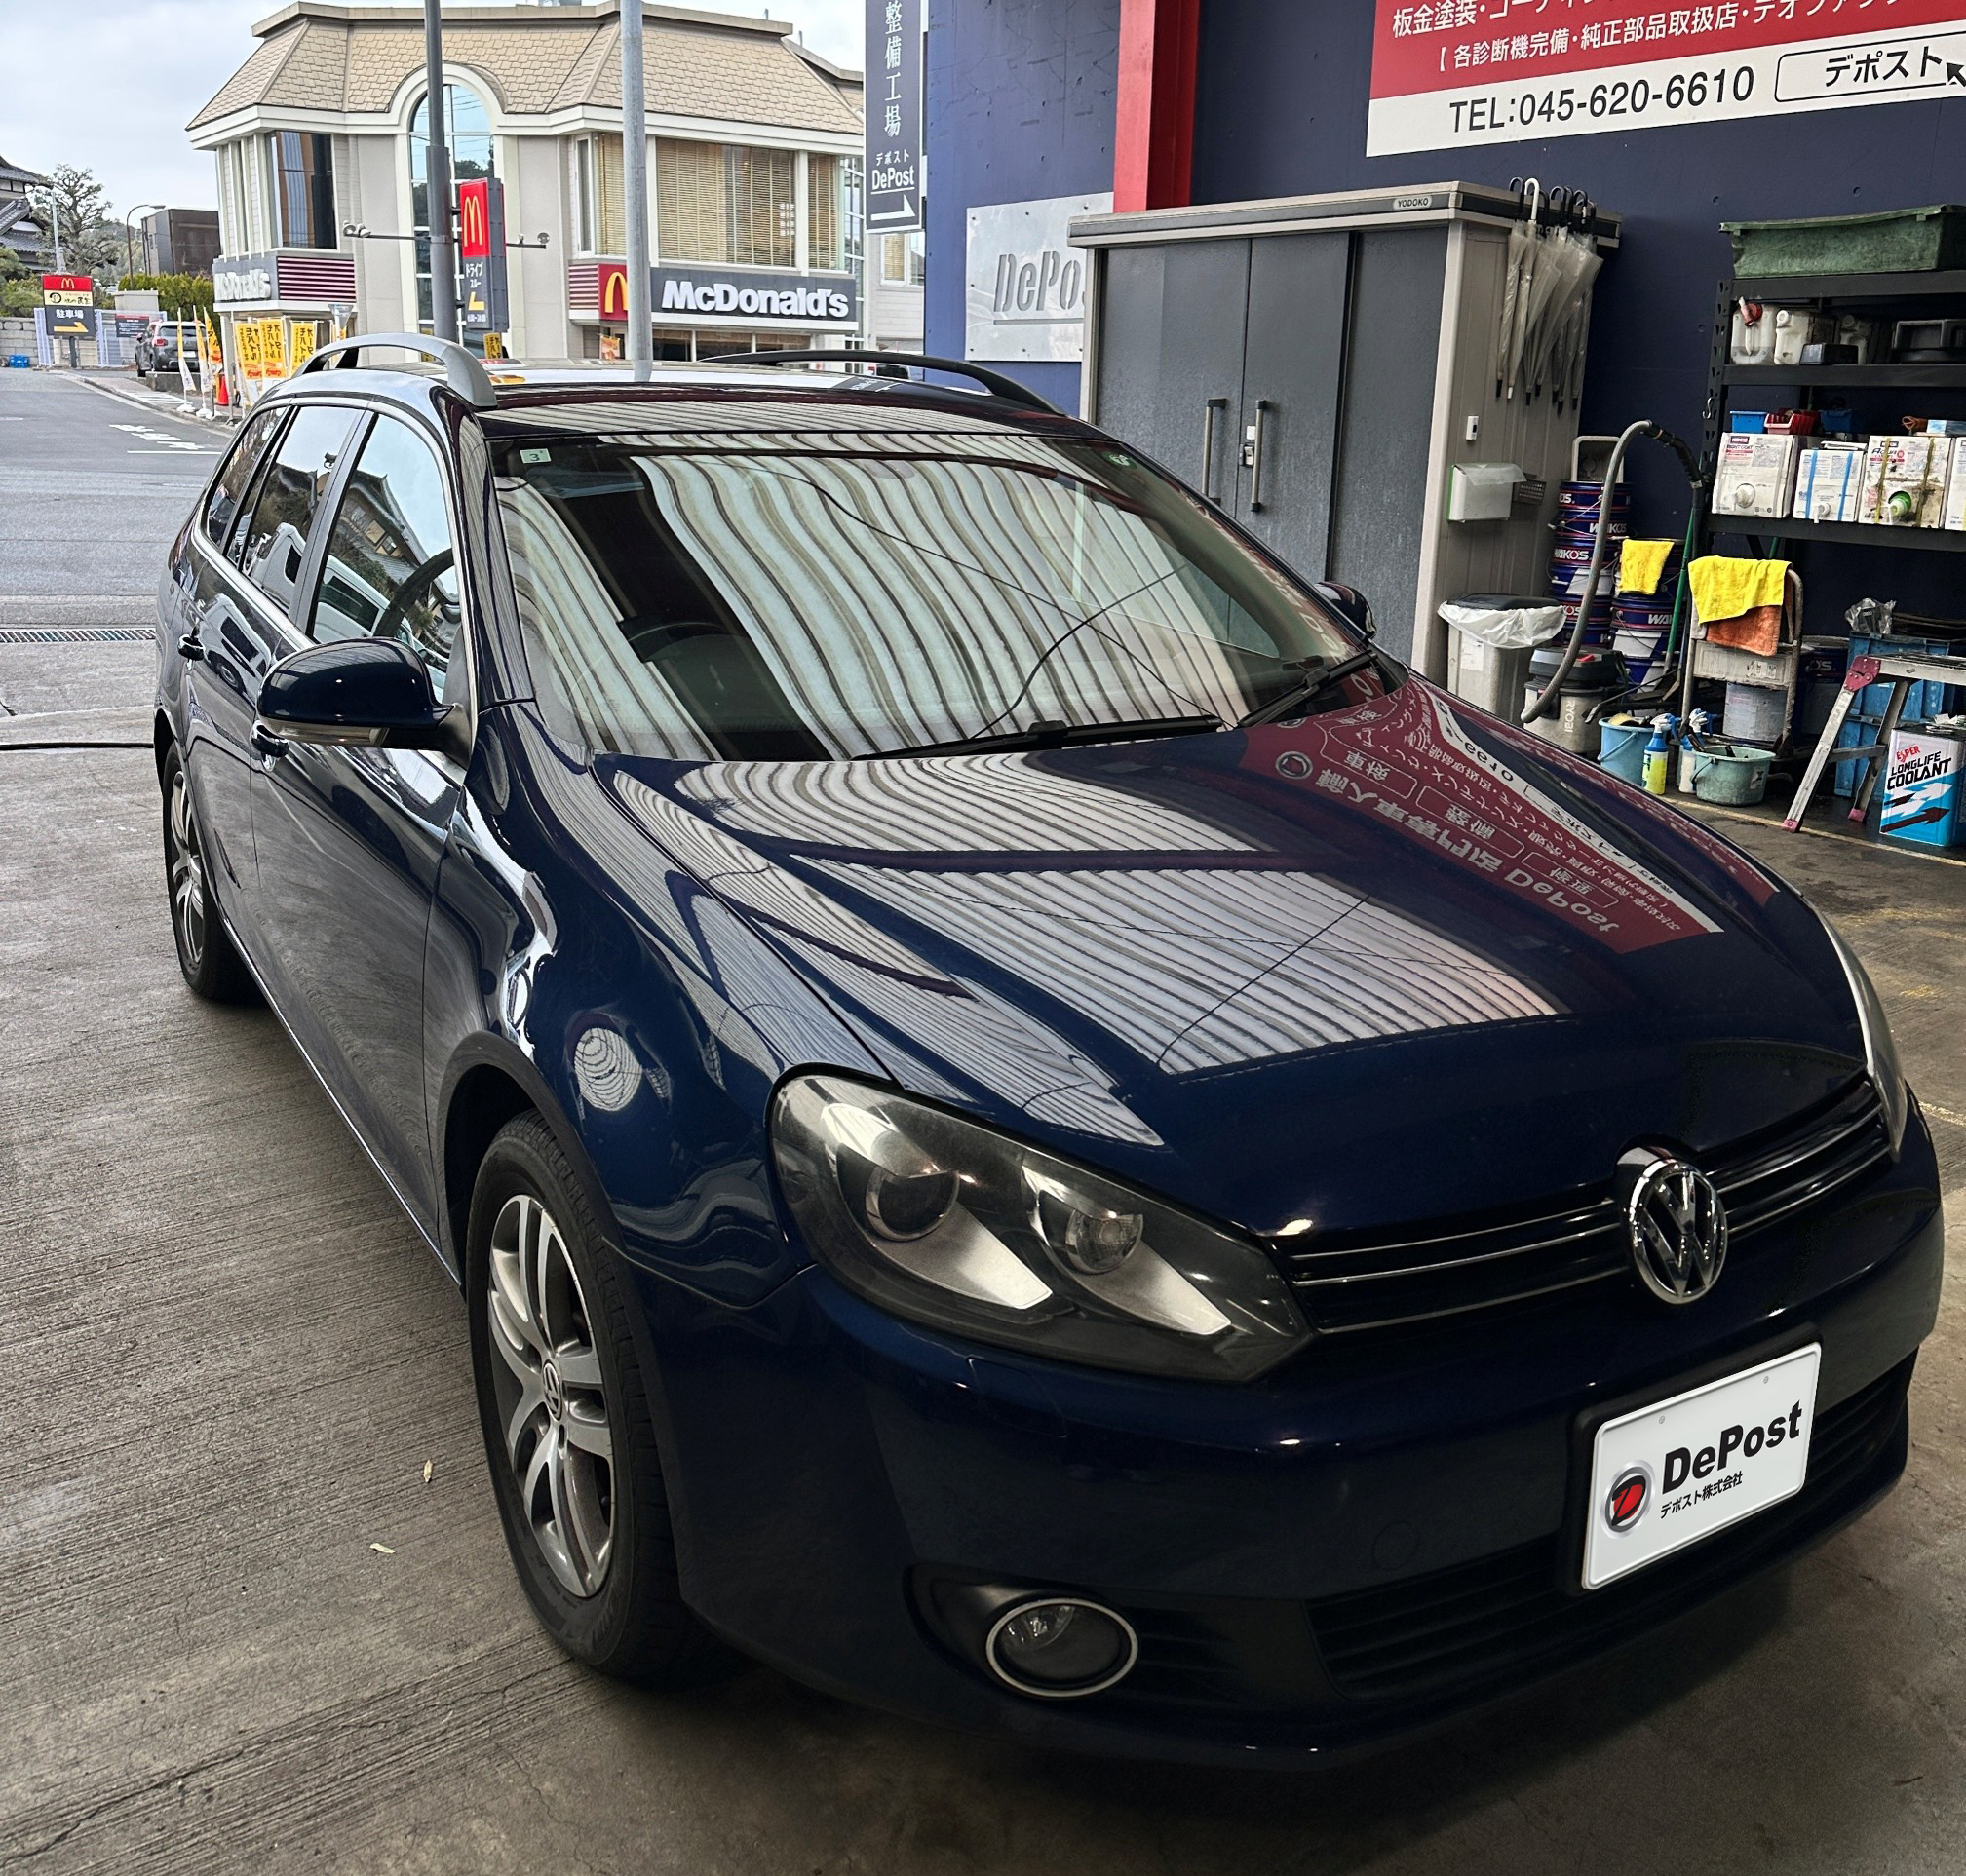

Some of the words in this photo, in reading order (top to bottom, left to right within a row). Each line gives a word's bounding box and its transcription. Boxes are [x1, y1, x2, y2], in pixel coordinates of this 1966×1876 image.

[884, 0, 903, 137] 整備工場
[1825, 46, 1943, 88] デポスト
[875, 148, 910, 167] デポスト
[871, 164, 915, 191] DePost
[1398, 198, 1429, 208] YODOKO
[56, 308, 84, 319] 駐車場
[661, 280, 850, 319] McDonald's
[1564, 700, 1576, 734] RYOBI
[1887, 757, 1952, 790] COOLANT
[1662, 1399, 1802, 1495] DePost
[1660, 1470, 1744, 1519] デポスト株式会社
